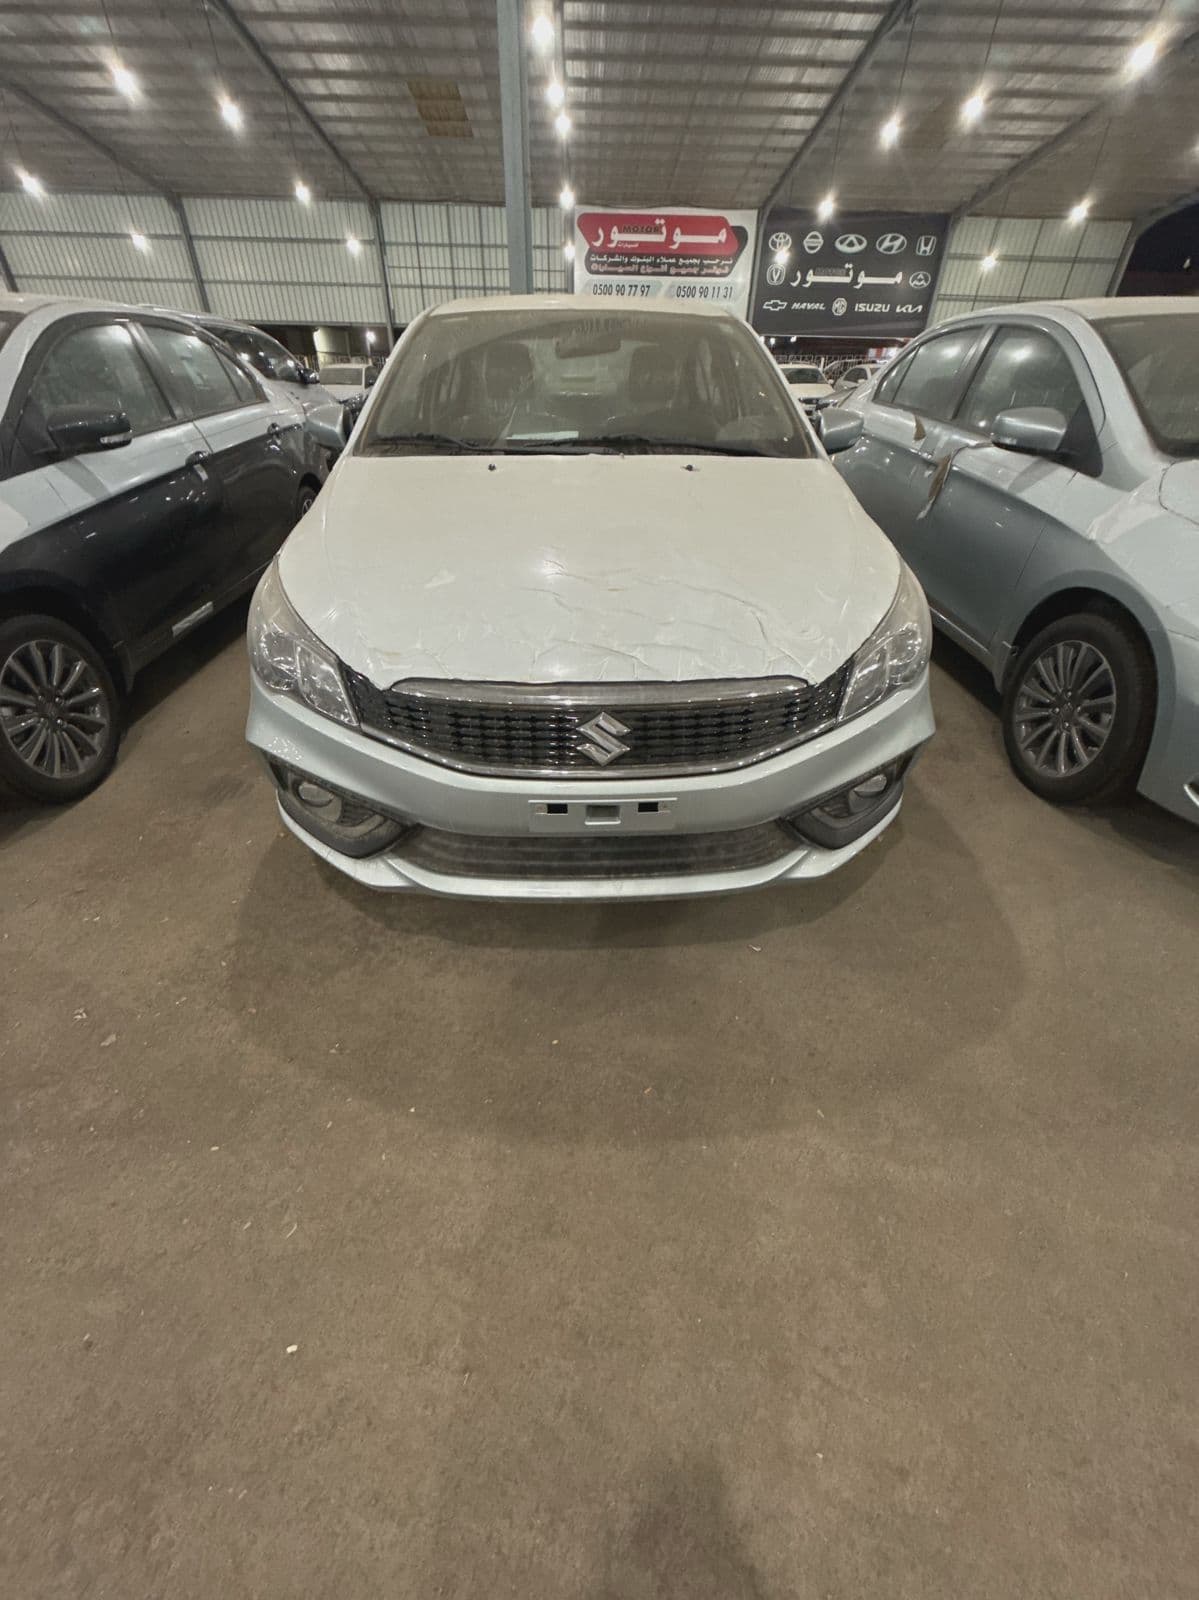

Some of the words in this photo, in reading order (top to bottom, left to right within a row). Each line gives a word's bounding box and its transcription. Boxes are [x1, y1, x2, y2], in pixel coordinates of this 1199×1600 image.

[591, 218, 727, 250] موتور
[790, 263, 903, 289] موتور
[593, 284, 613, 296] 0500
[615, 285, 626, 297] 90
[628, 285, 639, 297] 77
[640, 285, 651, 297] 97
[676, 286, 697, 298] 0500
[699, 286, 710, 298] 90
[711, 286, 721, 299] 11
[722, 286, 733, 299] 31
[791, 302, 826, 311] HAVAL
[854, 302, 890, 313] ISUZU
